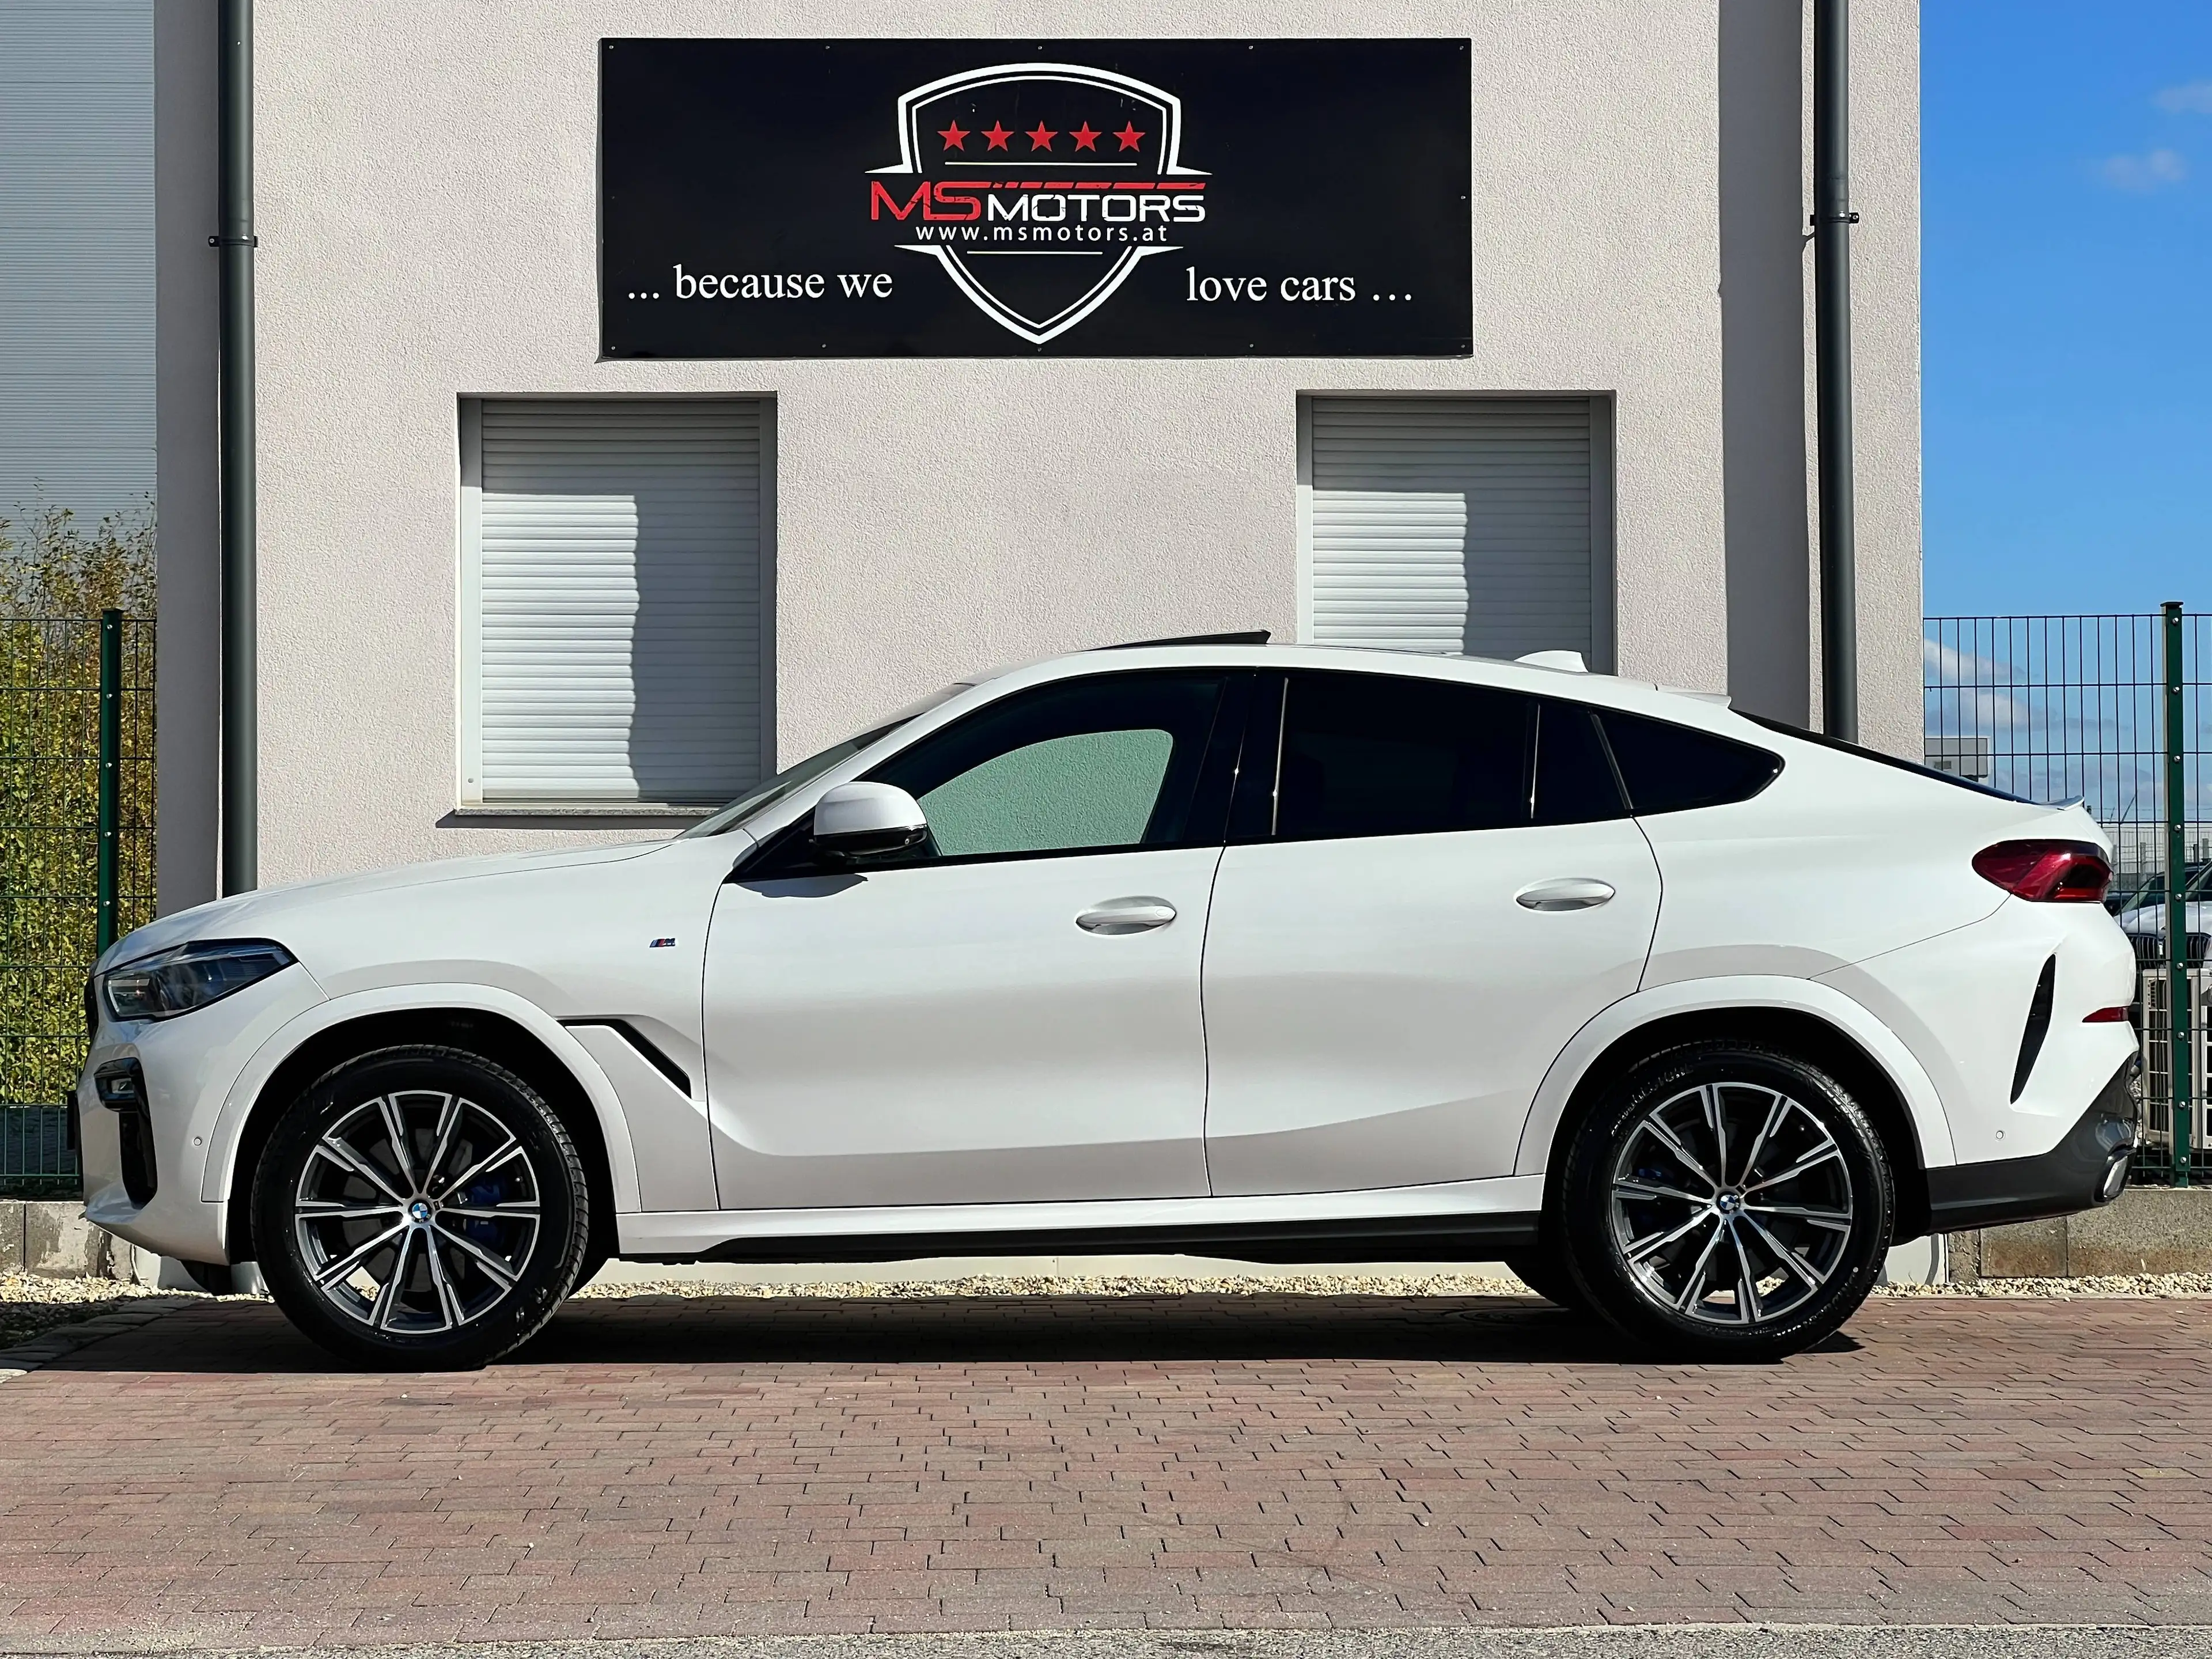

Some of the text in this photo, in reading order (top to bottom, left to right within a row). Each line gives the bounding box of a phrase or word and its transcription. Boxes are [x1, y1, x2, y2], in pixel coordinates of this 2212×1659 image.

[915, 224, 1167, 241] www.msmotors.at
[673, 263, 825, 299] because
[836, 274, 892, 298] we
[1186, 266, 1267, 301] love
[1281, 277, 1356, 301] cars
